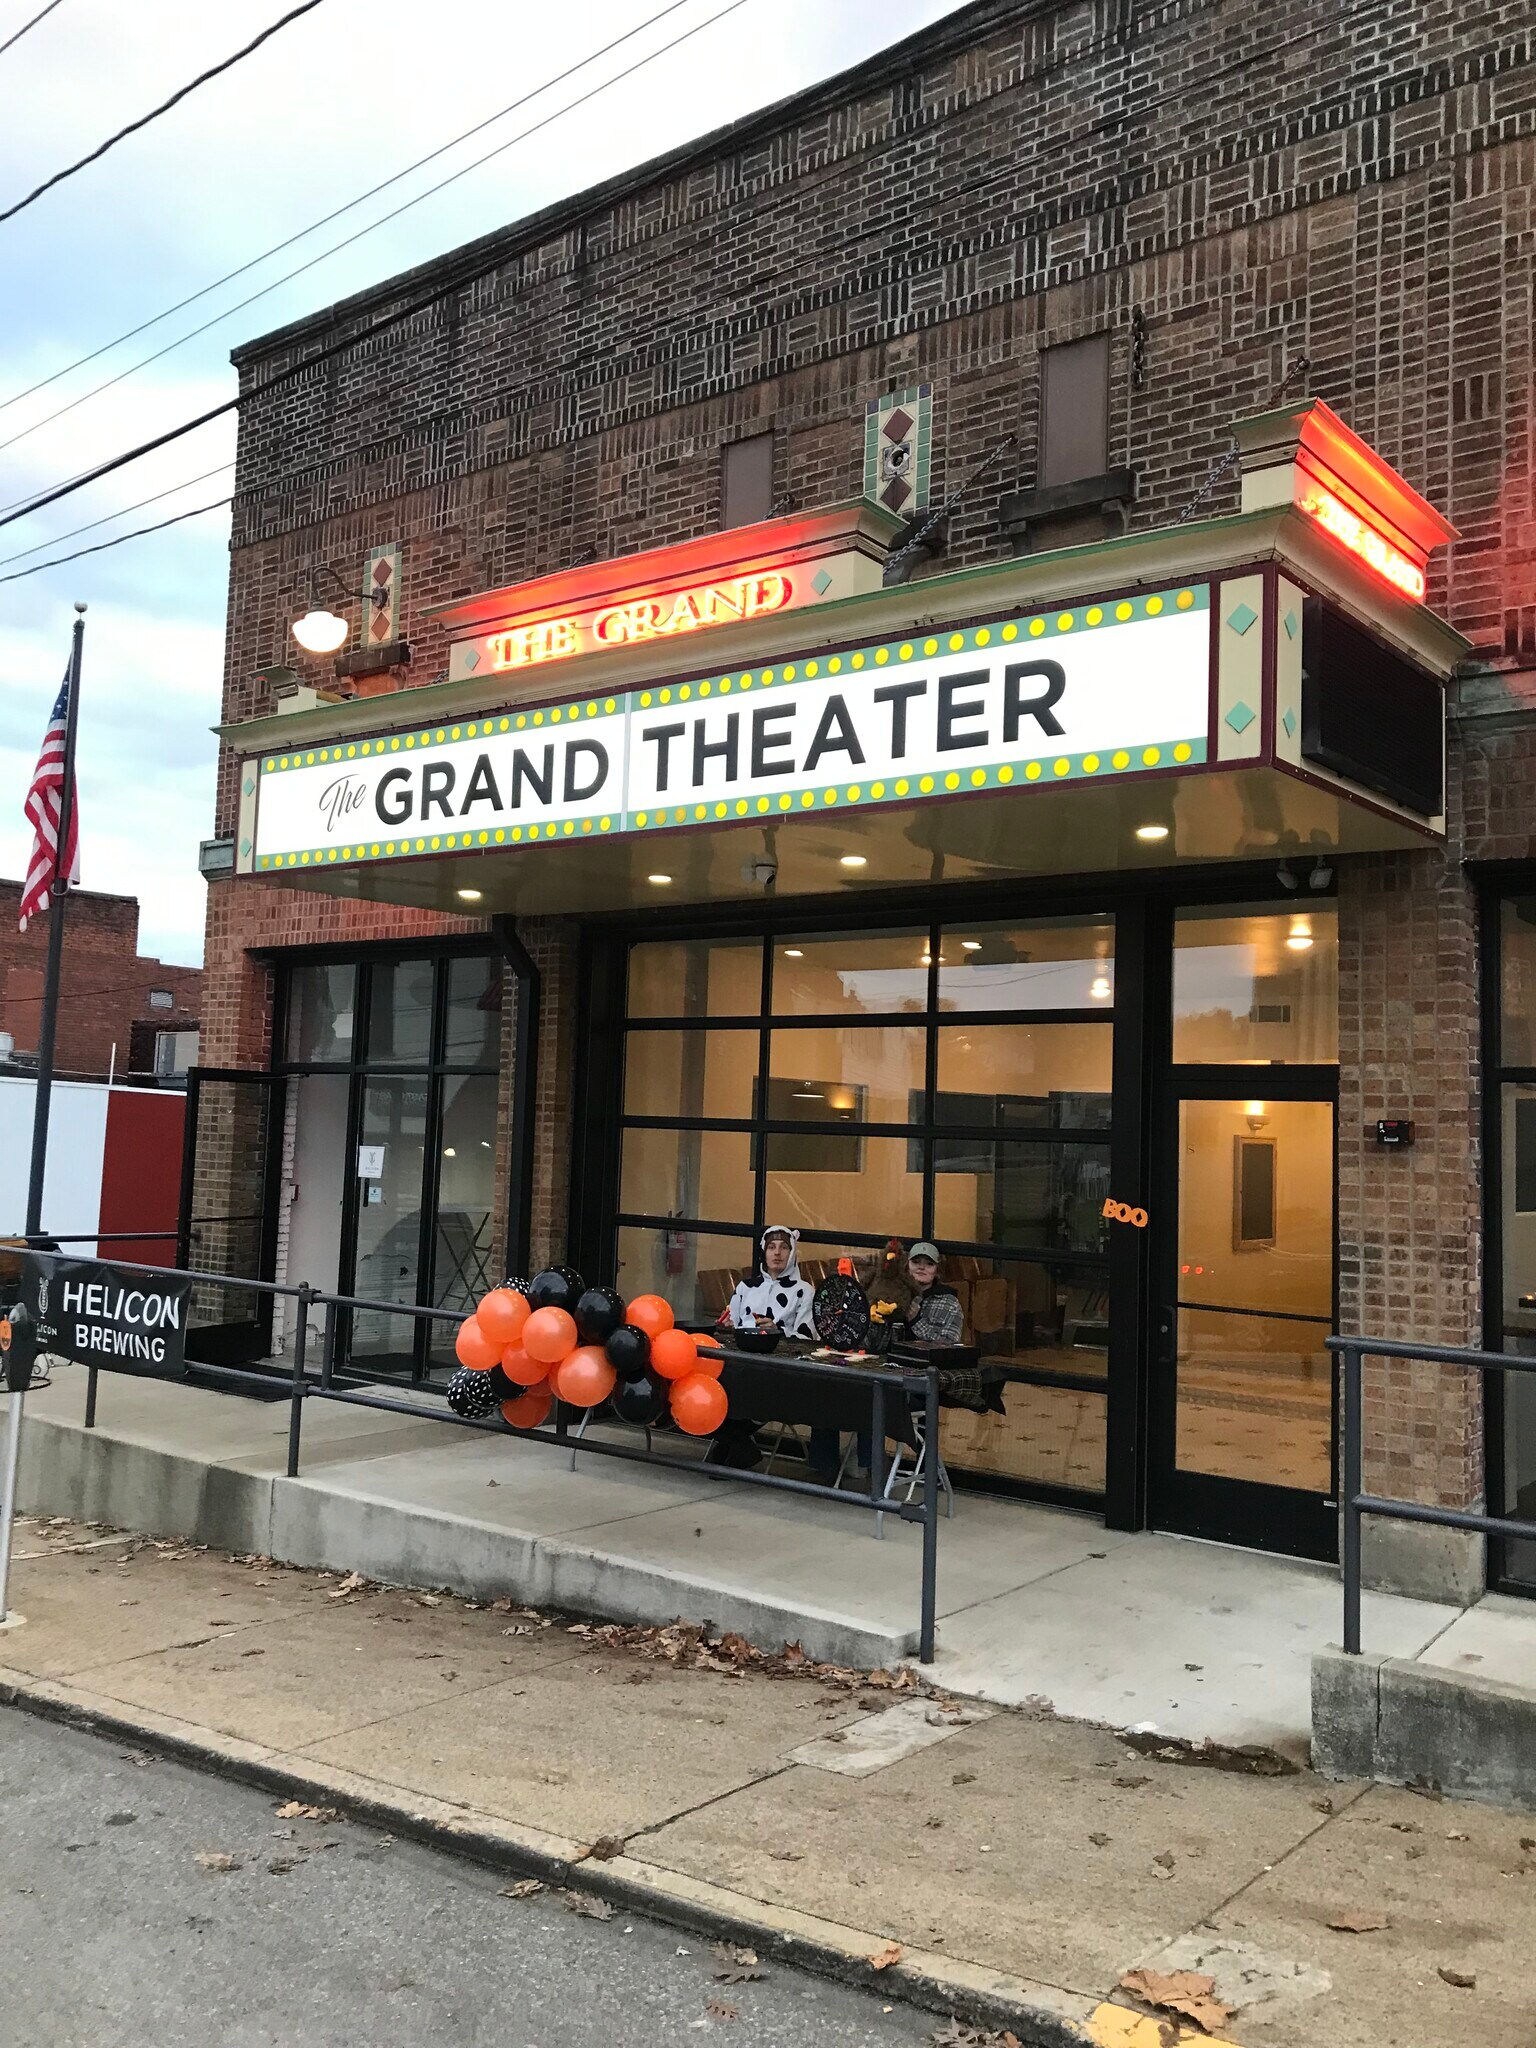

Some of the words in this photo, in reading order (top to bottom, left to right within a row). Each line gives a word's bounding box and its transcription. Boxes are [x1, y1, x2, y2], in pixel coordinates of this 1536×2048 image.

[487, 618, 578, 671] THE
[593, 572, 793, 645] GRAND
[319, 773, 368, 832] The
[374, 738, 610, 826] GRAND
[641, 658, 1068, 792] THEATER
[1102, 1197, 1149, 1228] BOO
[62, 1280, 180, 1331] HELICON
[75, 1323, 166, 1363] BREWING
